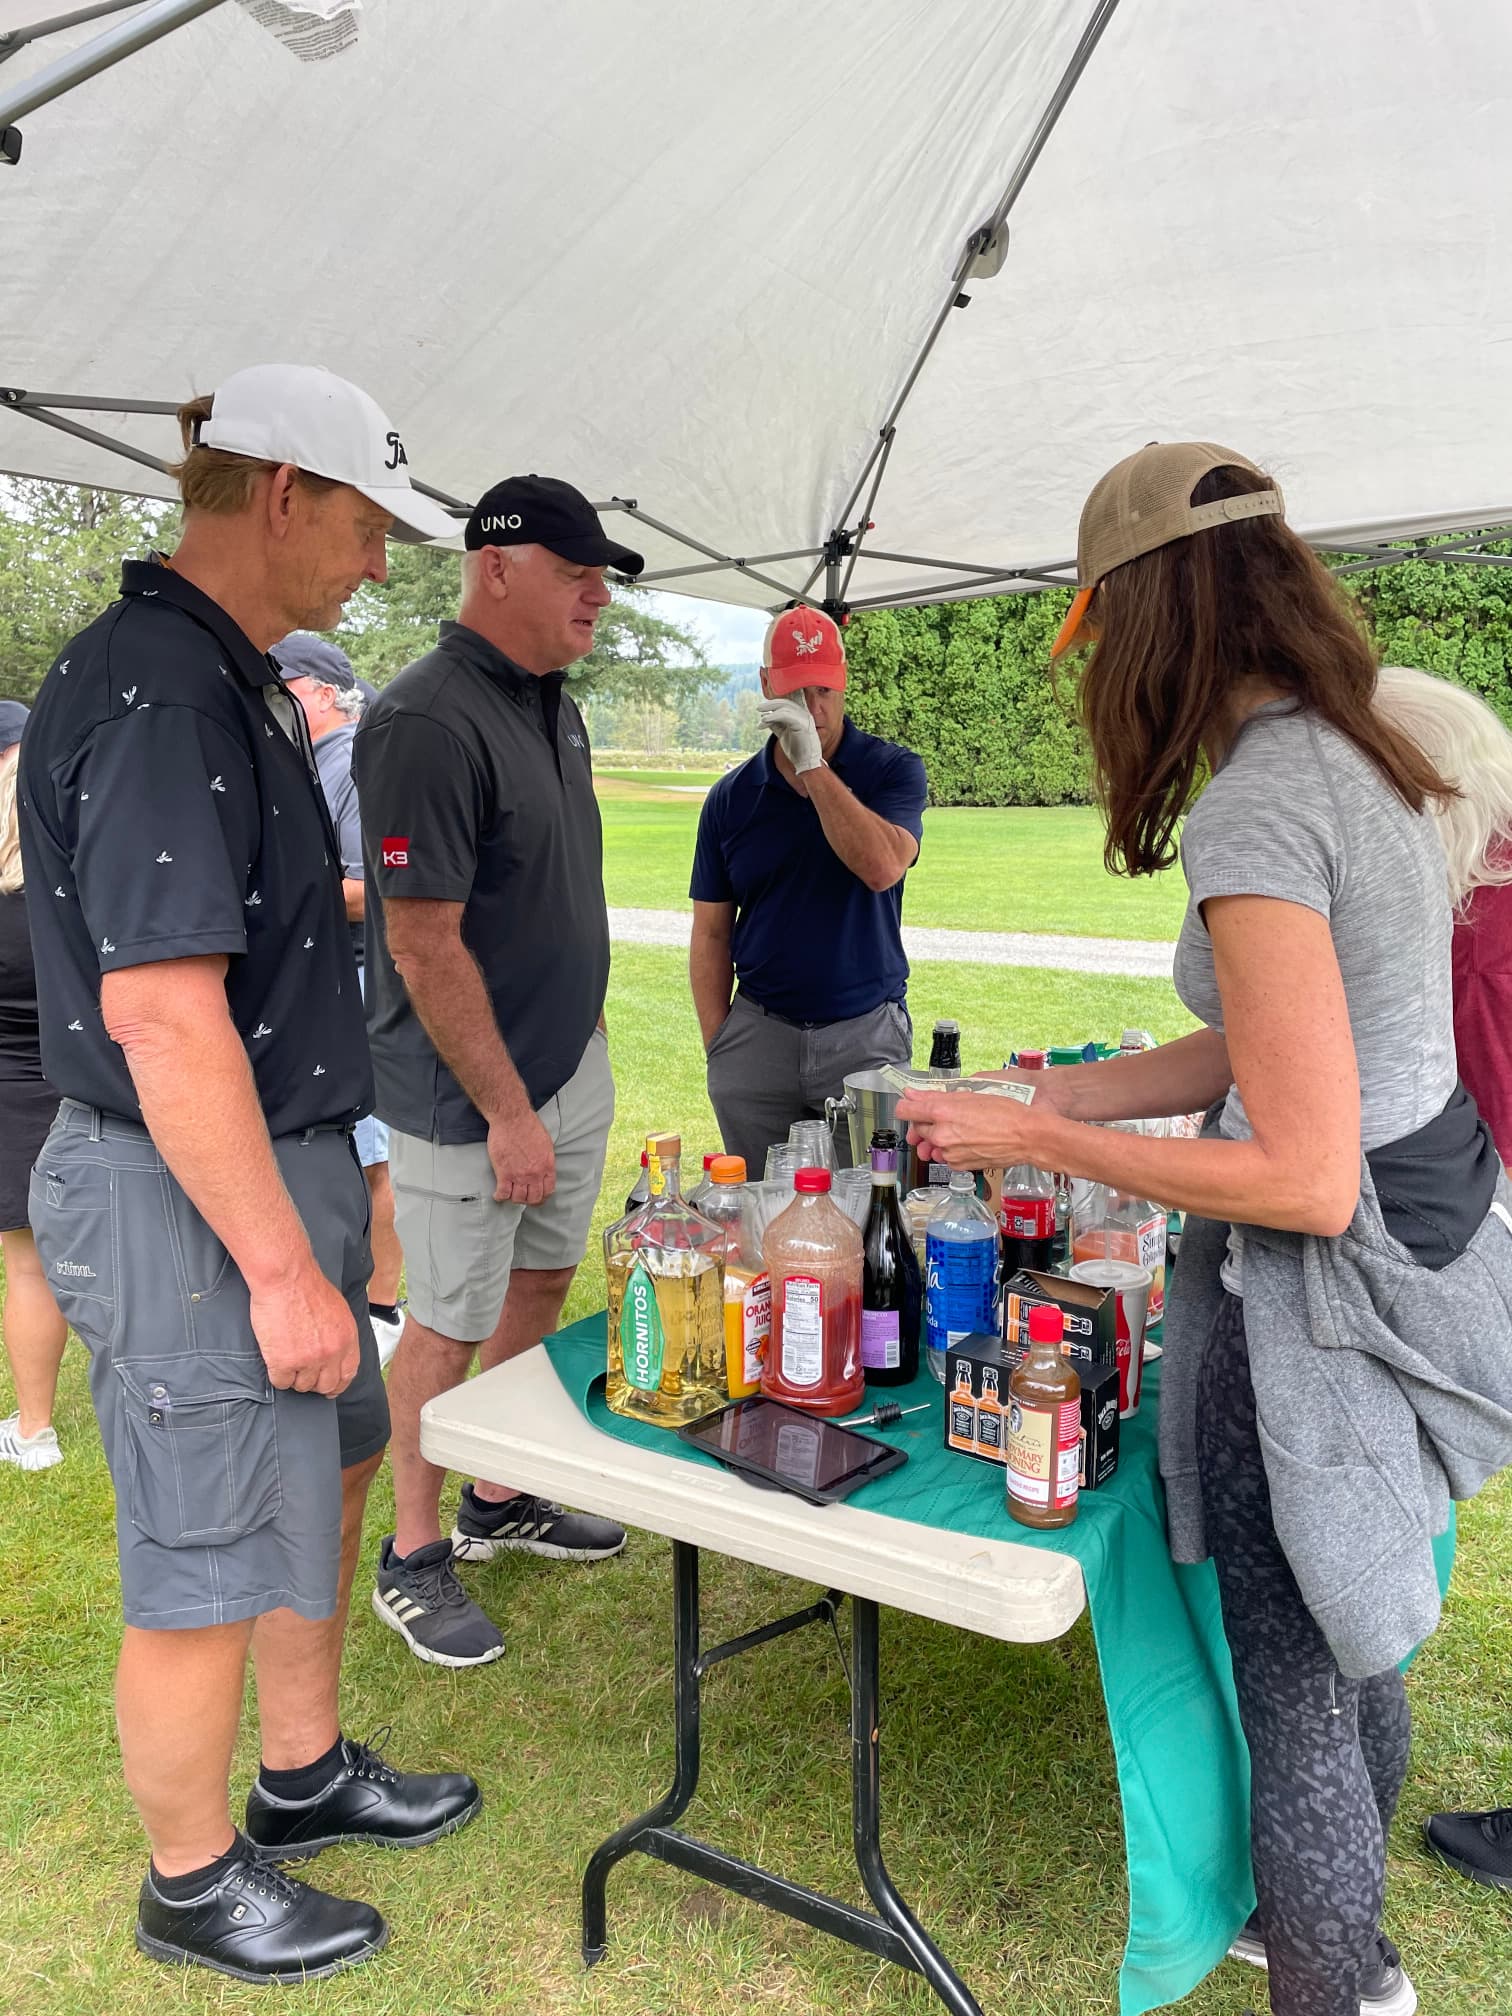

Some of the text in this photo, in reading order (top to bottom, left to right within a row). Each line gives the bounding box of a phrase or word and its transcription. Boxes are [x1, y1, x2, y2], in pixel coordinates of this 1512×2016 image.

[480, 514, 522, 532] UNO
[633, 1284, 650, 1383] HORNITOS
[1018, 1446, 1044, 1464] MARY
